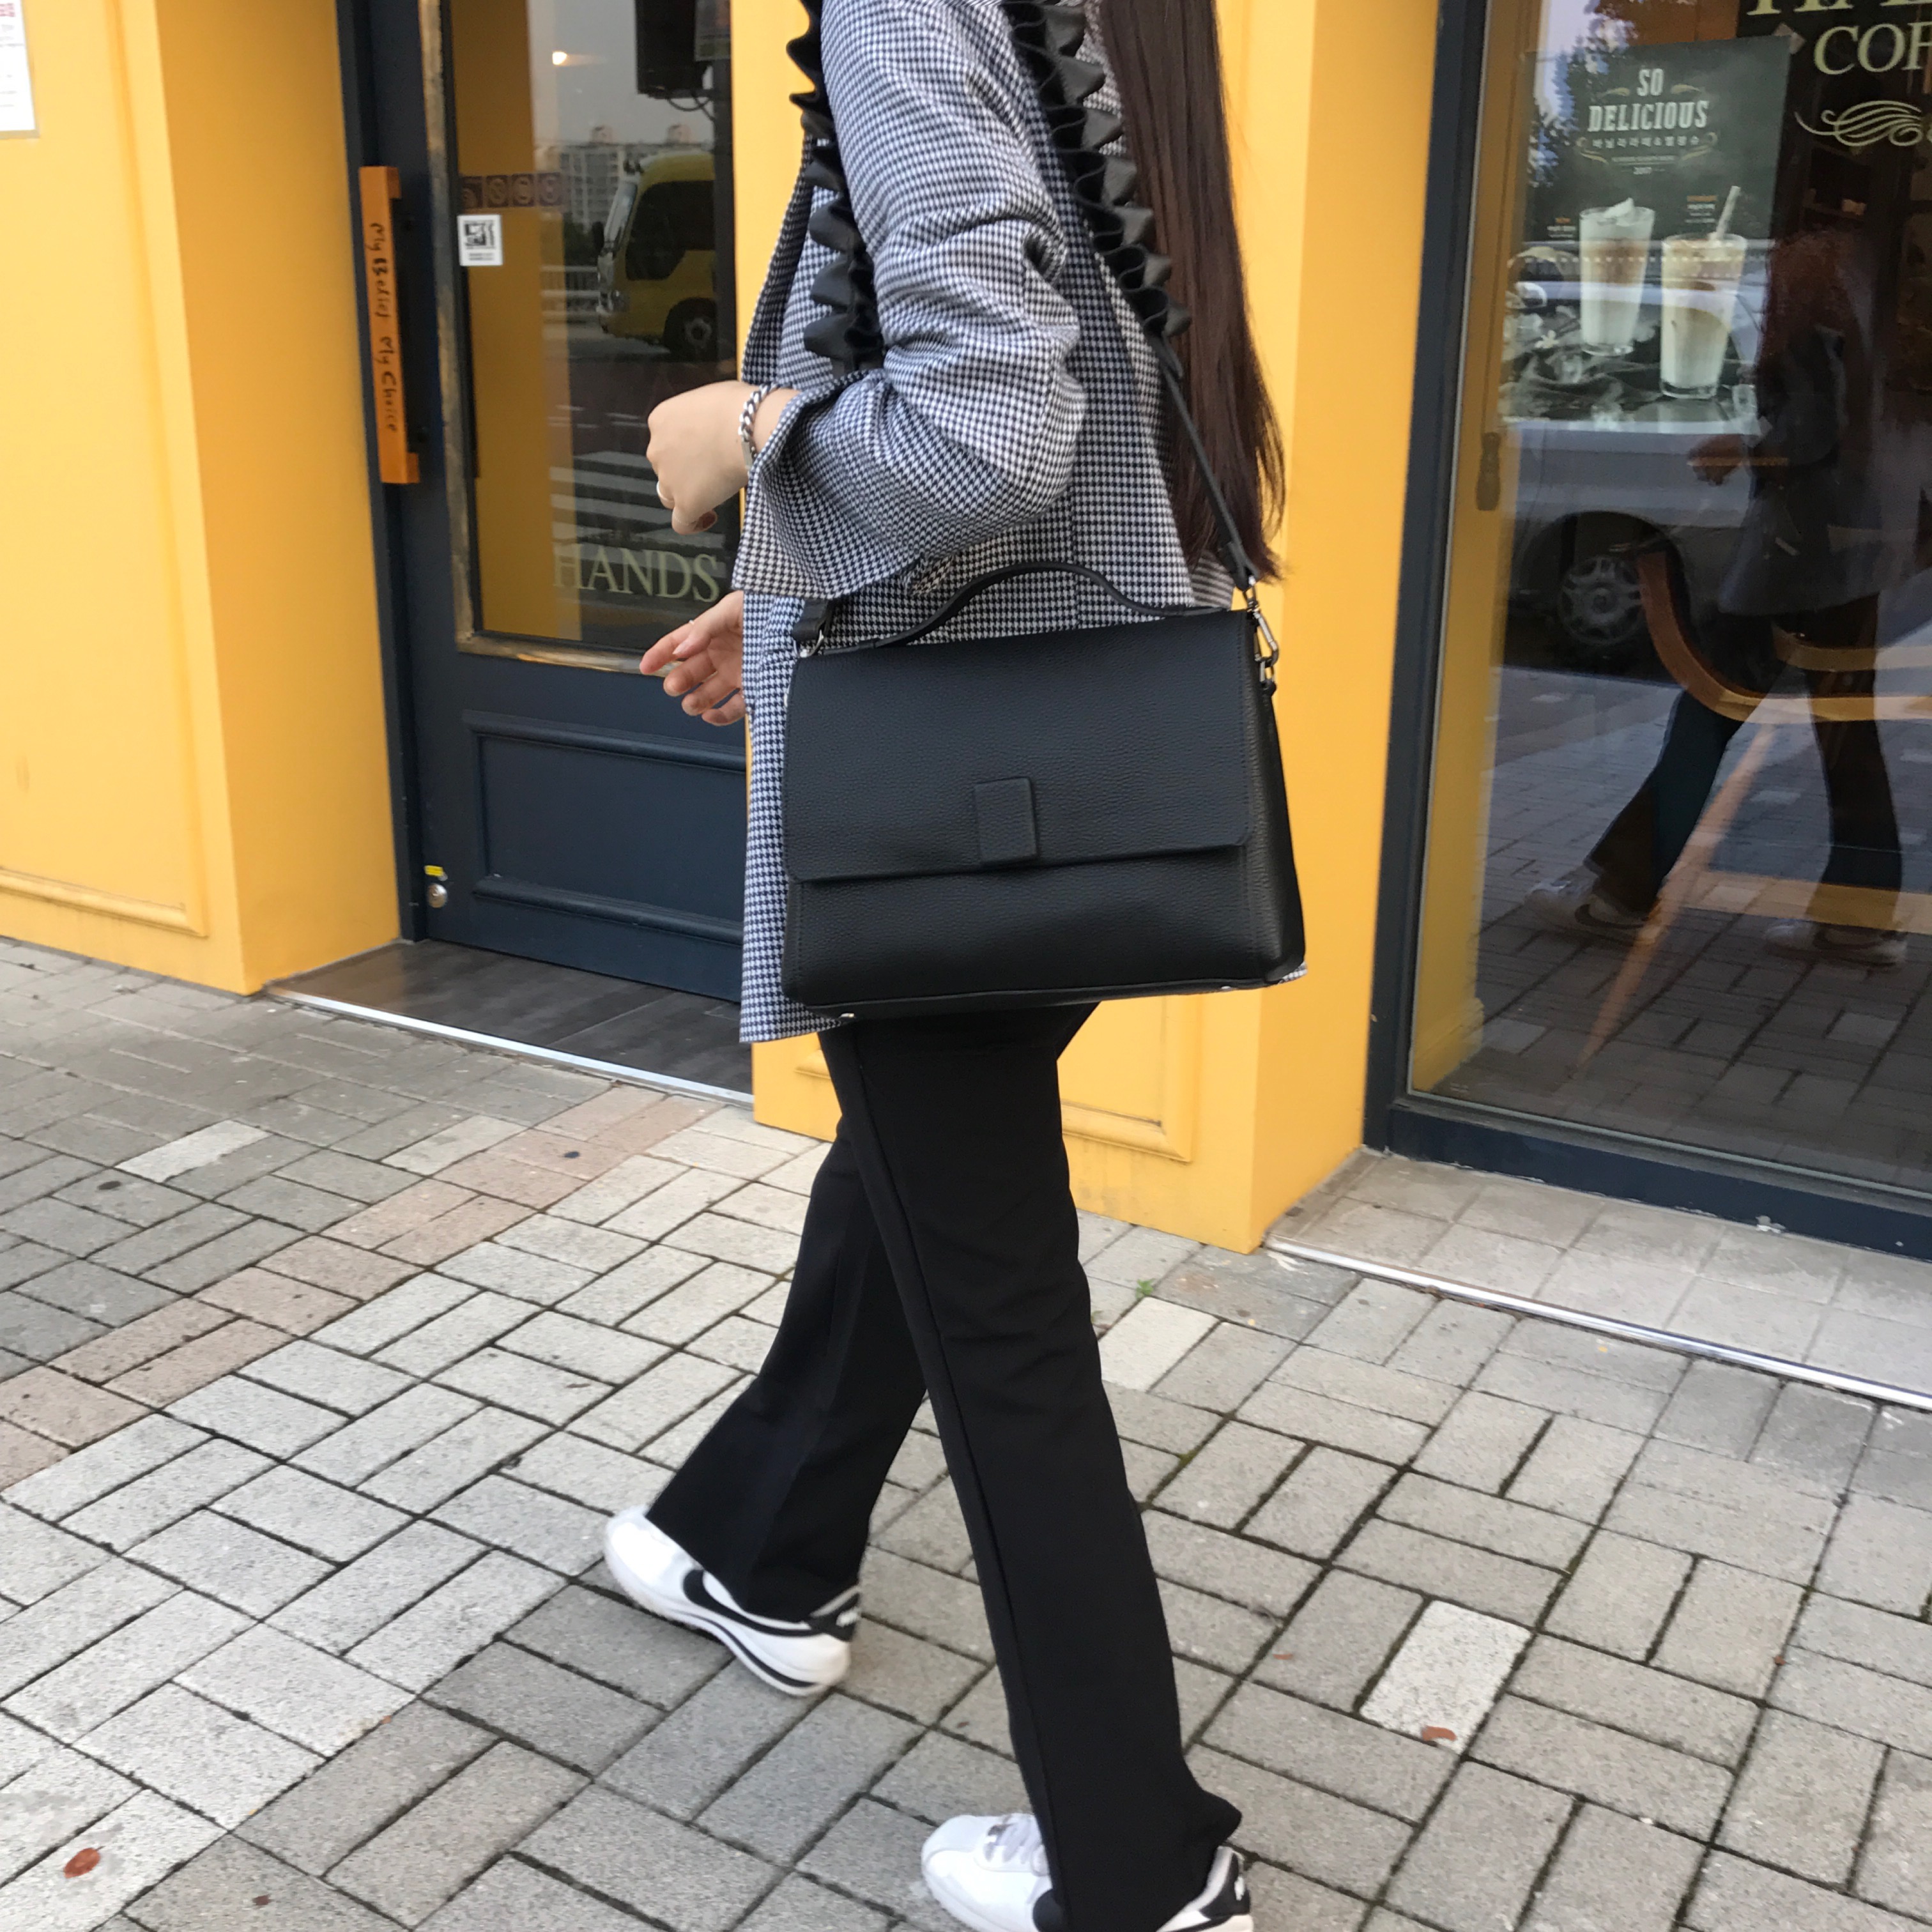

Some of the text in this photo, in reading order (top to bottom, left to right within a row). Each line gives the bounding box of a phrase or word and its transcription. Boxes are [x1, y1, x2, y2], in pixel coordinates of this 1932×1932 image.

[1637, 68, 1664, 96] SO
[1587, 100, 1710, 132] DELICIOUS
[373, 336, 394, 365] My
[553, 542, 719, 602] HANDS
